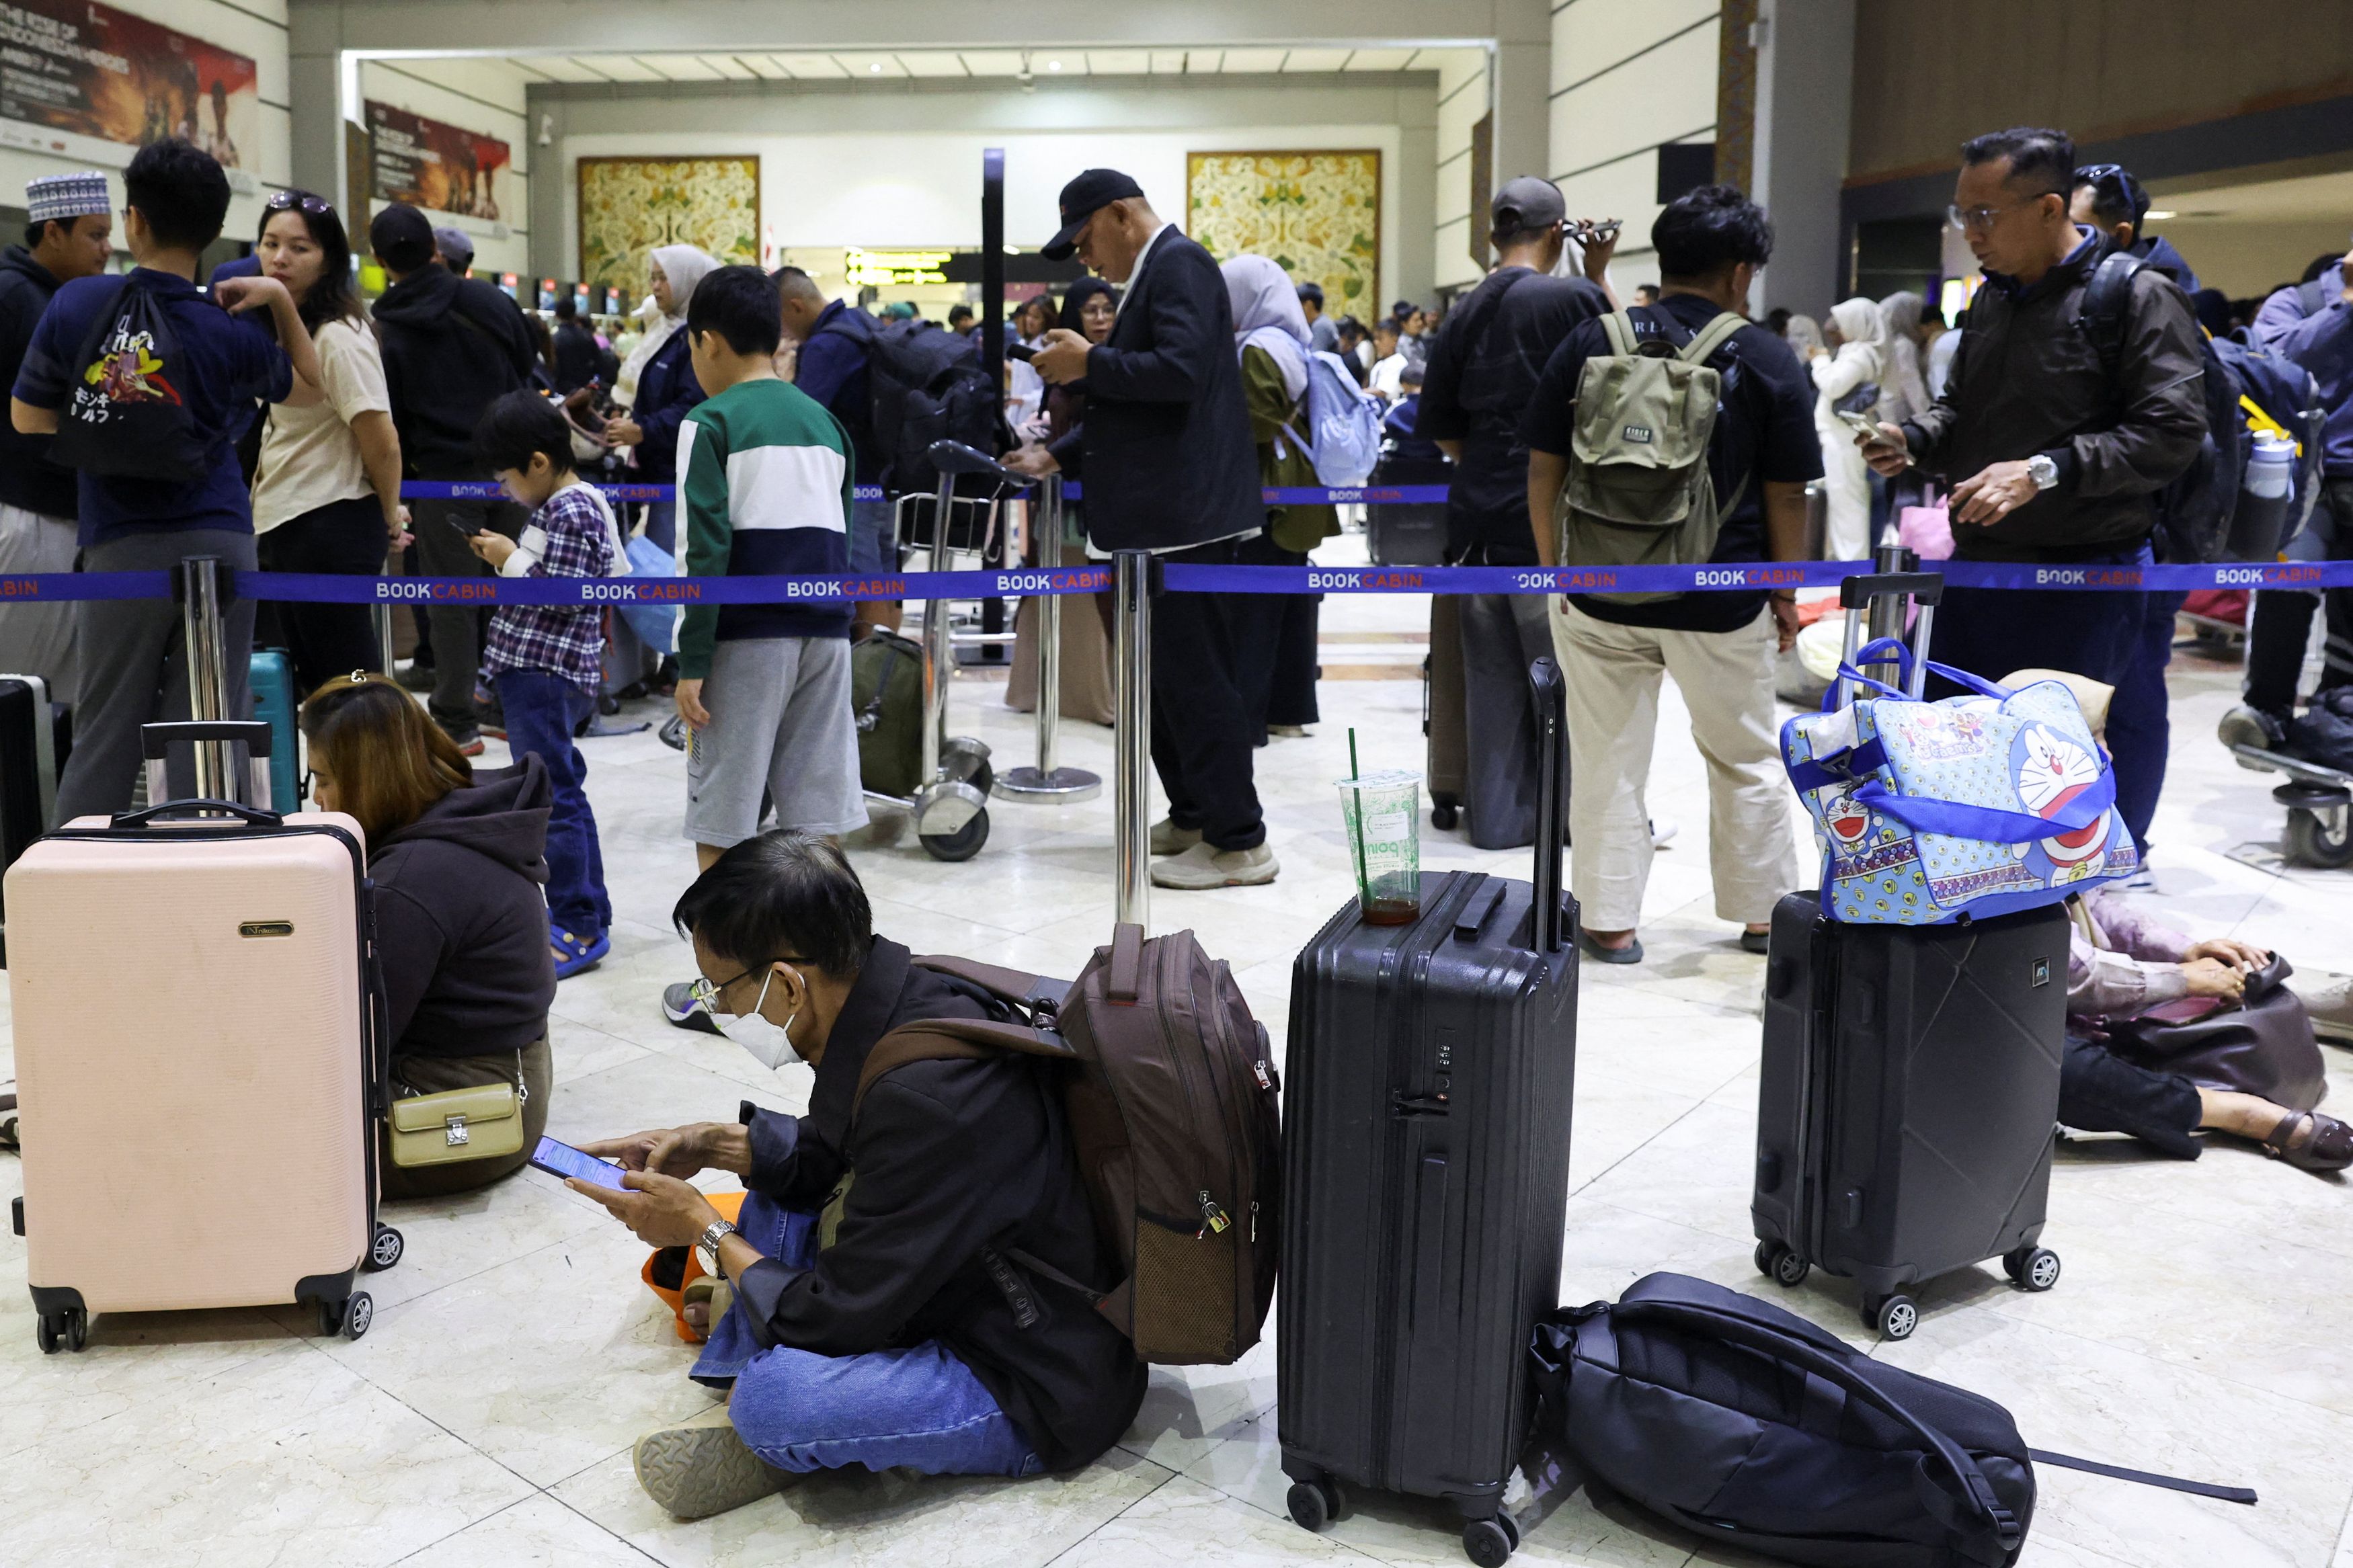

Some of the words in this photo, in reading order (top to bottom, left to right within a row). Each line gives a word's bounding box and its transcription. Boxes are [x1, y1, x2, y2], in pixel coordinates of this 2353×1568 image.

[1308, 573, 1423, 588] BOOKCABIN
[1513, 573, 1616, 589] OOKCABIN
[1696, 570, 1804, 586] BOOKCABIN
[2215, 567, 2322, 584] BOOKCABIN
[376, 583, 496, 599] BOOKCABIN
[582, 583, 701, 600] BOOKCABIN
[787, 580, 905, 597] BOOKCABIN
